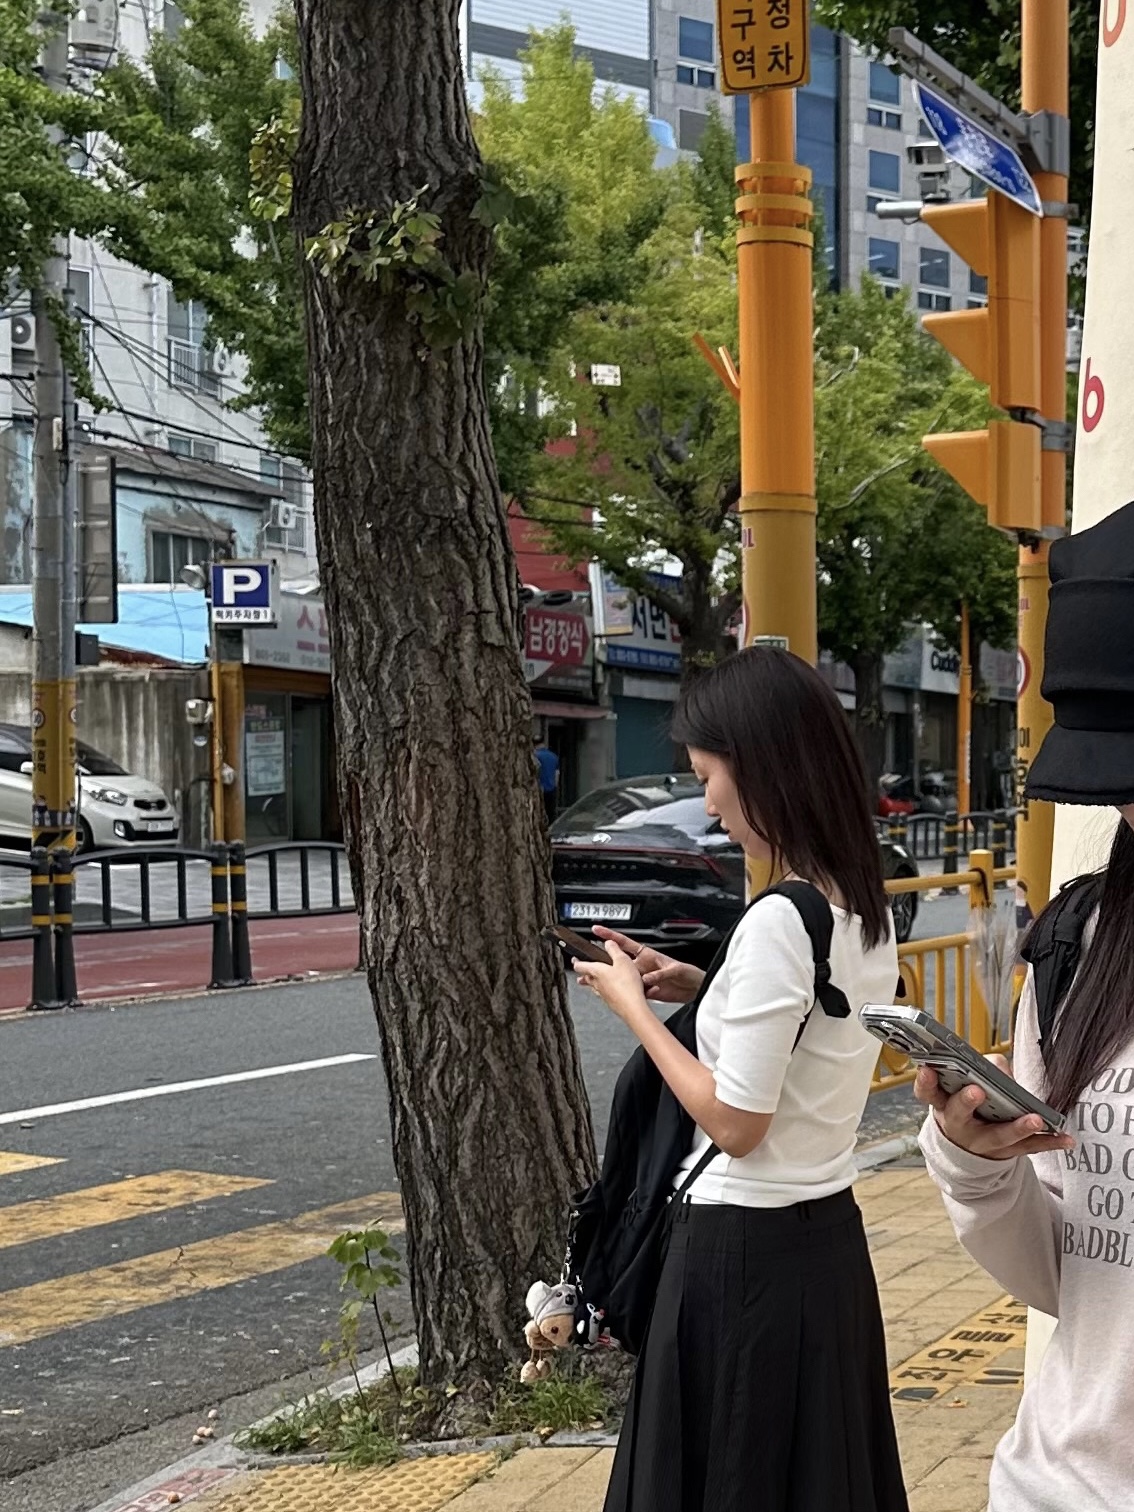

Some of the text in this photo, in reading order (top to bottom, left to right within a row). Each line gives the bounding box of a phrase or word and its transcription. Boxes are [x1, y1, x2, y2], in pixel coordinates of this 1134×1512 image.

[223, 568, 262, 605] P
[529, 613, 584, 661] 남경장식
[1077, 1101, 1115, 1134] TO
[1064, 1142, 1113, 1176] BAD
[1087, 1184, 1124, 1220] GO
